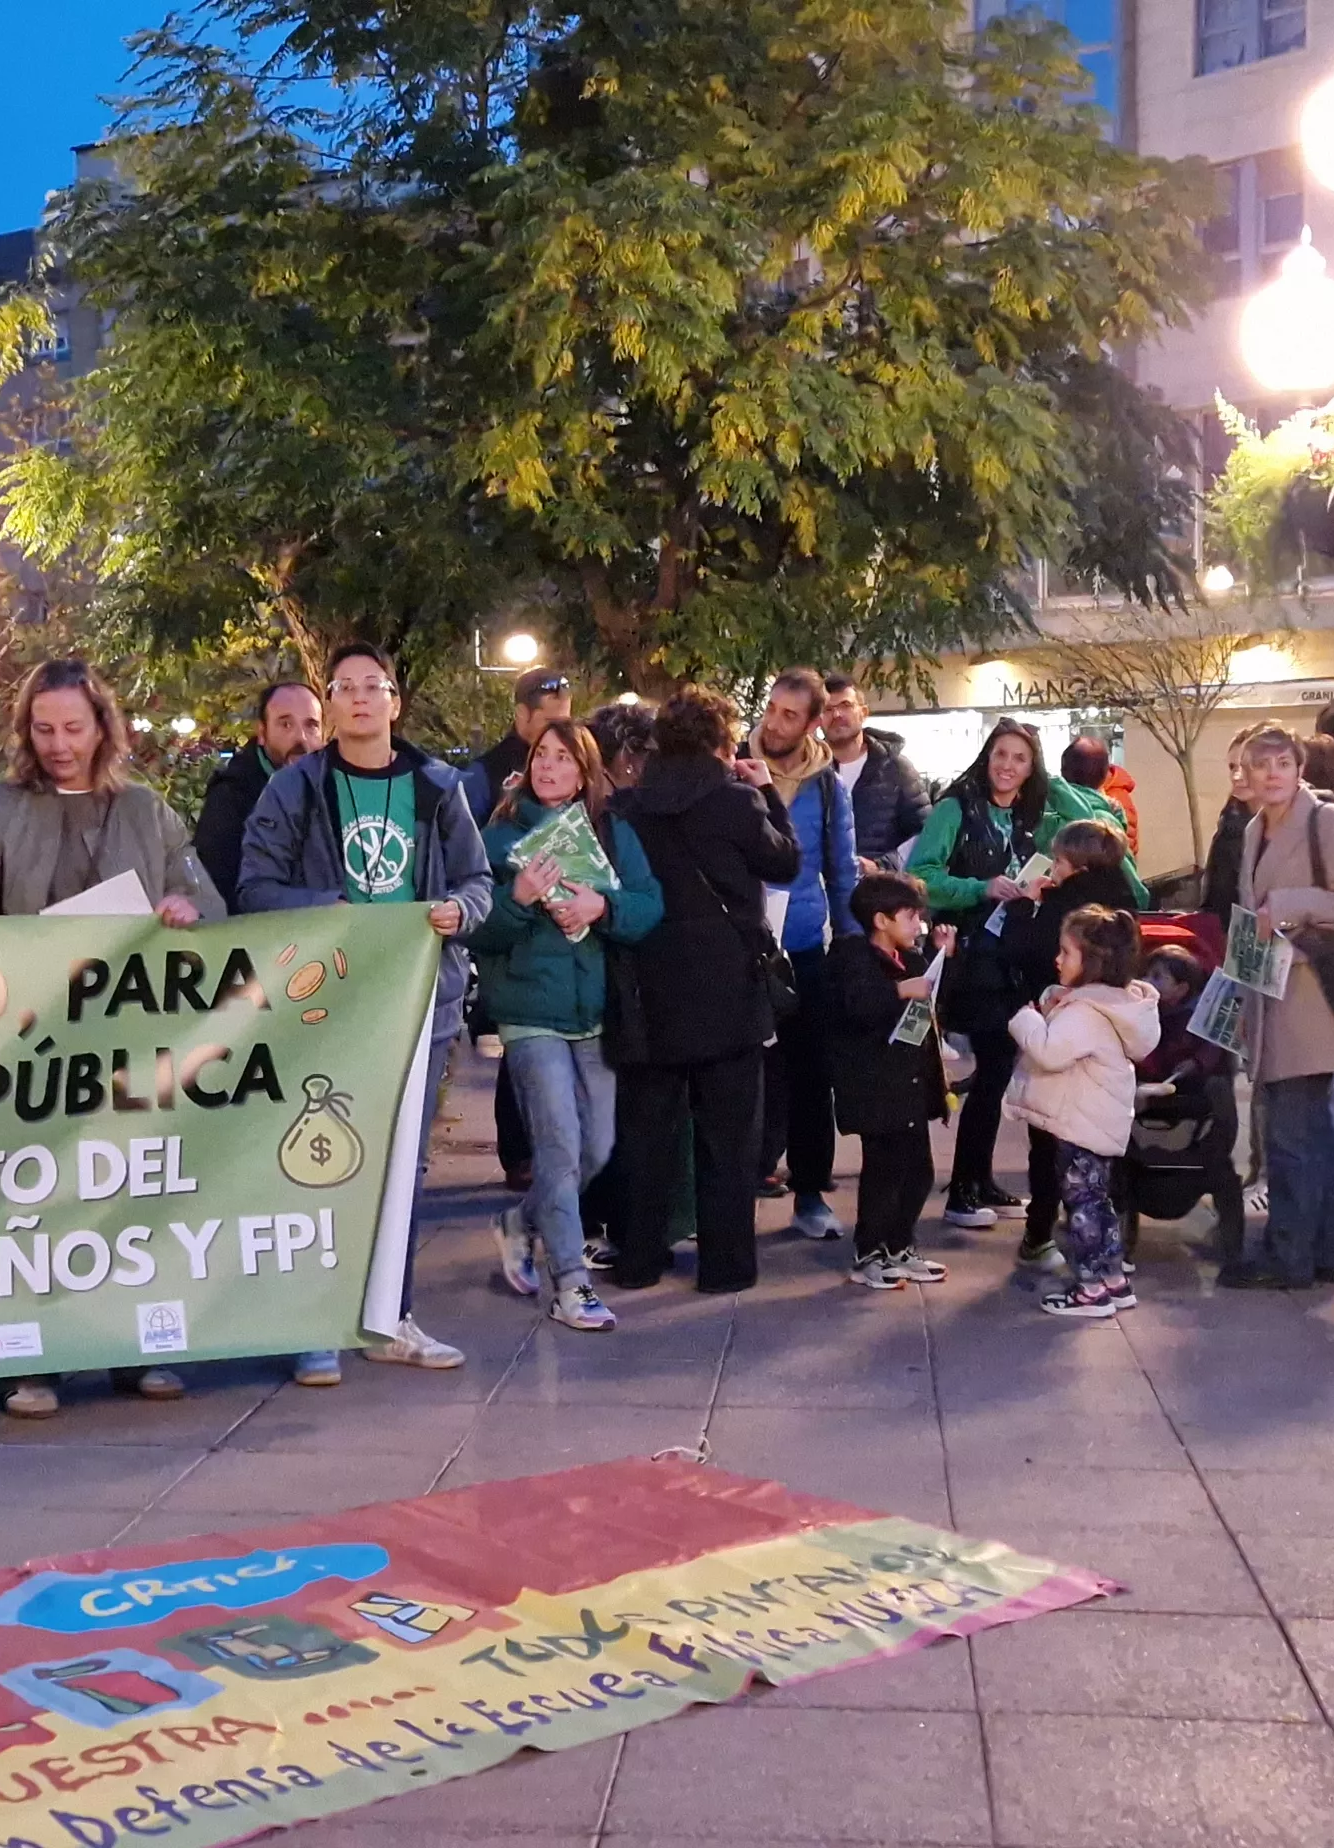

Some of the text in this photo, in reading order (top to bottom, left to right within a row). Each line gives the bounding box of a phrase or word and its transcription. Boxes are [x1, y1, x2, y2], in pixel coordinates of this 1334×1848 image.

[67, 947, 273, 1023] PARA
[78, 1135, 198, 1202] DEL
[170, 1218, 223, 1280] Y
[239, 1207, 338, 1276] FP!
[49, 1766, 325, 1848] Defensa
[327, 1740, 424, 1772] de
